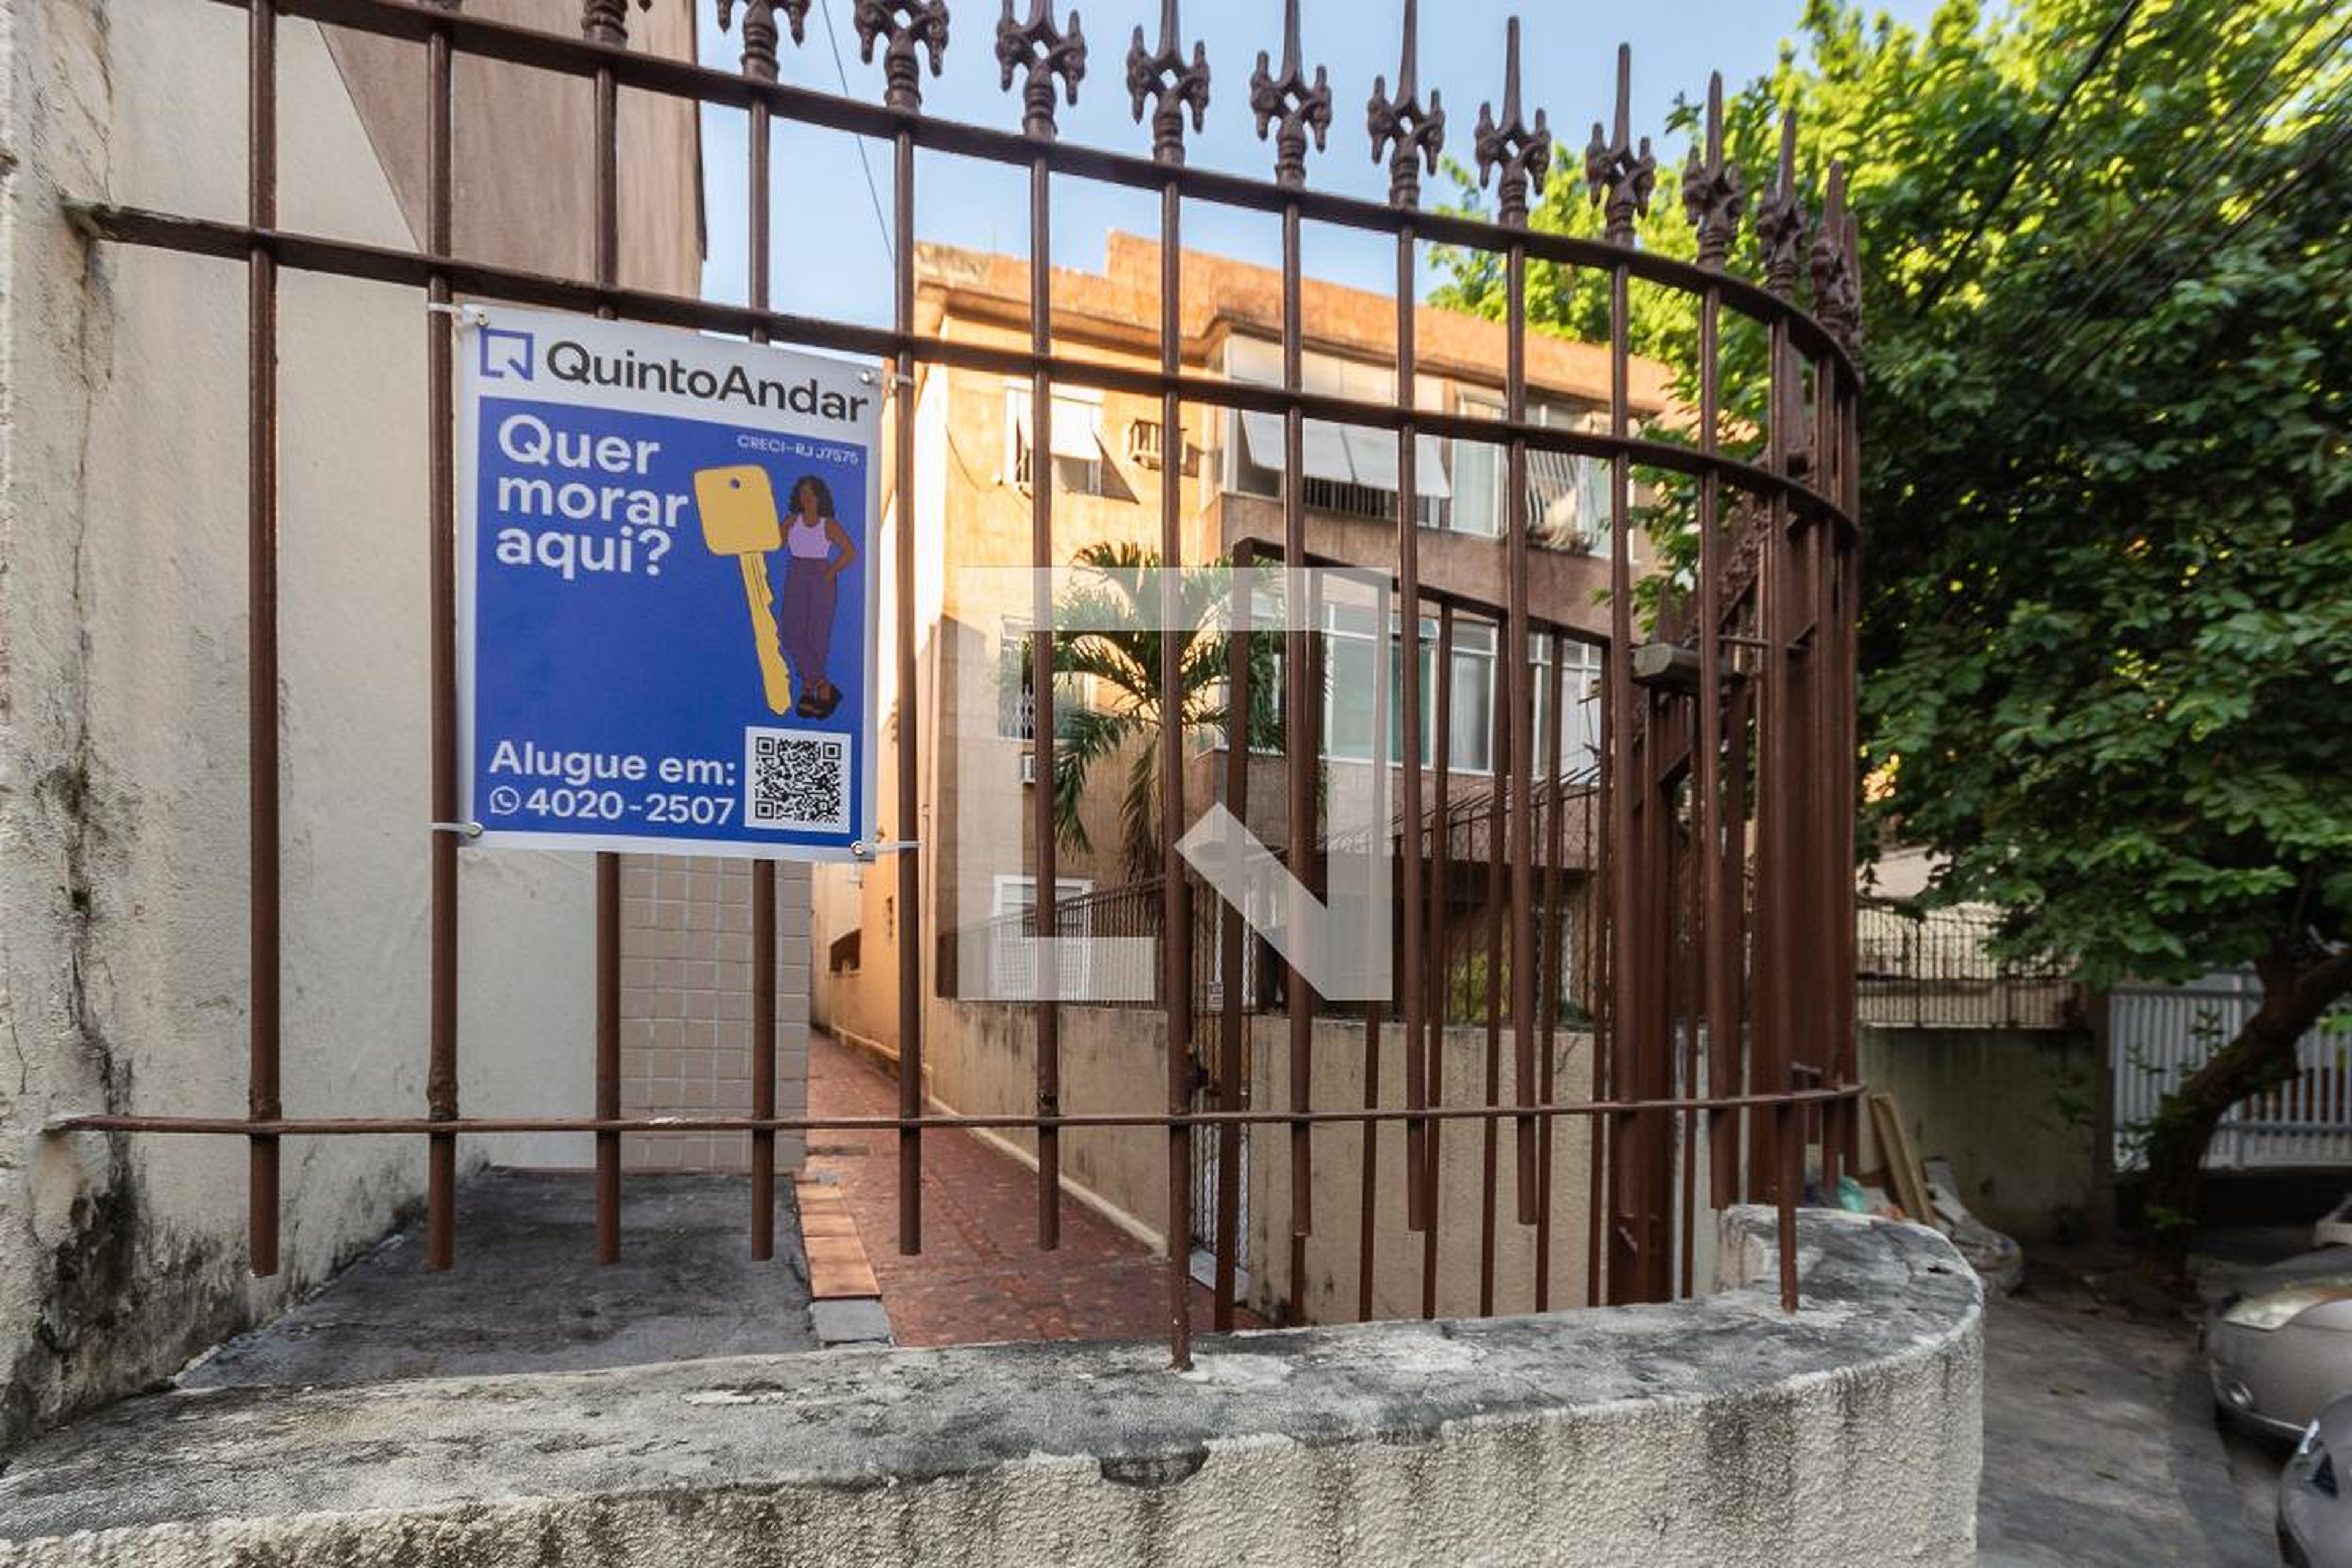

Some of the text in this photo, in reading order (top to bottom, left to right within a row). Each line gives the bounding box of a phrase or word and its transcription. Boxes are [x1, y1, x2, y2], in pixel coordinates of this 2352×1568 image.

[547, 341, 868, 421] QuintoAndar
[499, 415, 661, 474] Quer
[498, 476, 688, 527] morar
[496, 526, 671, 580] aqui?
[489, 741, 735, 786] Alugue em:
[526, 788, 735, 825] 4020-2507
